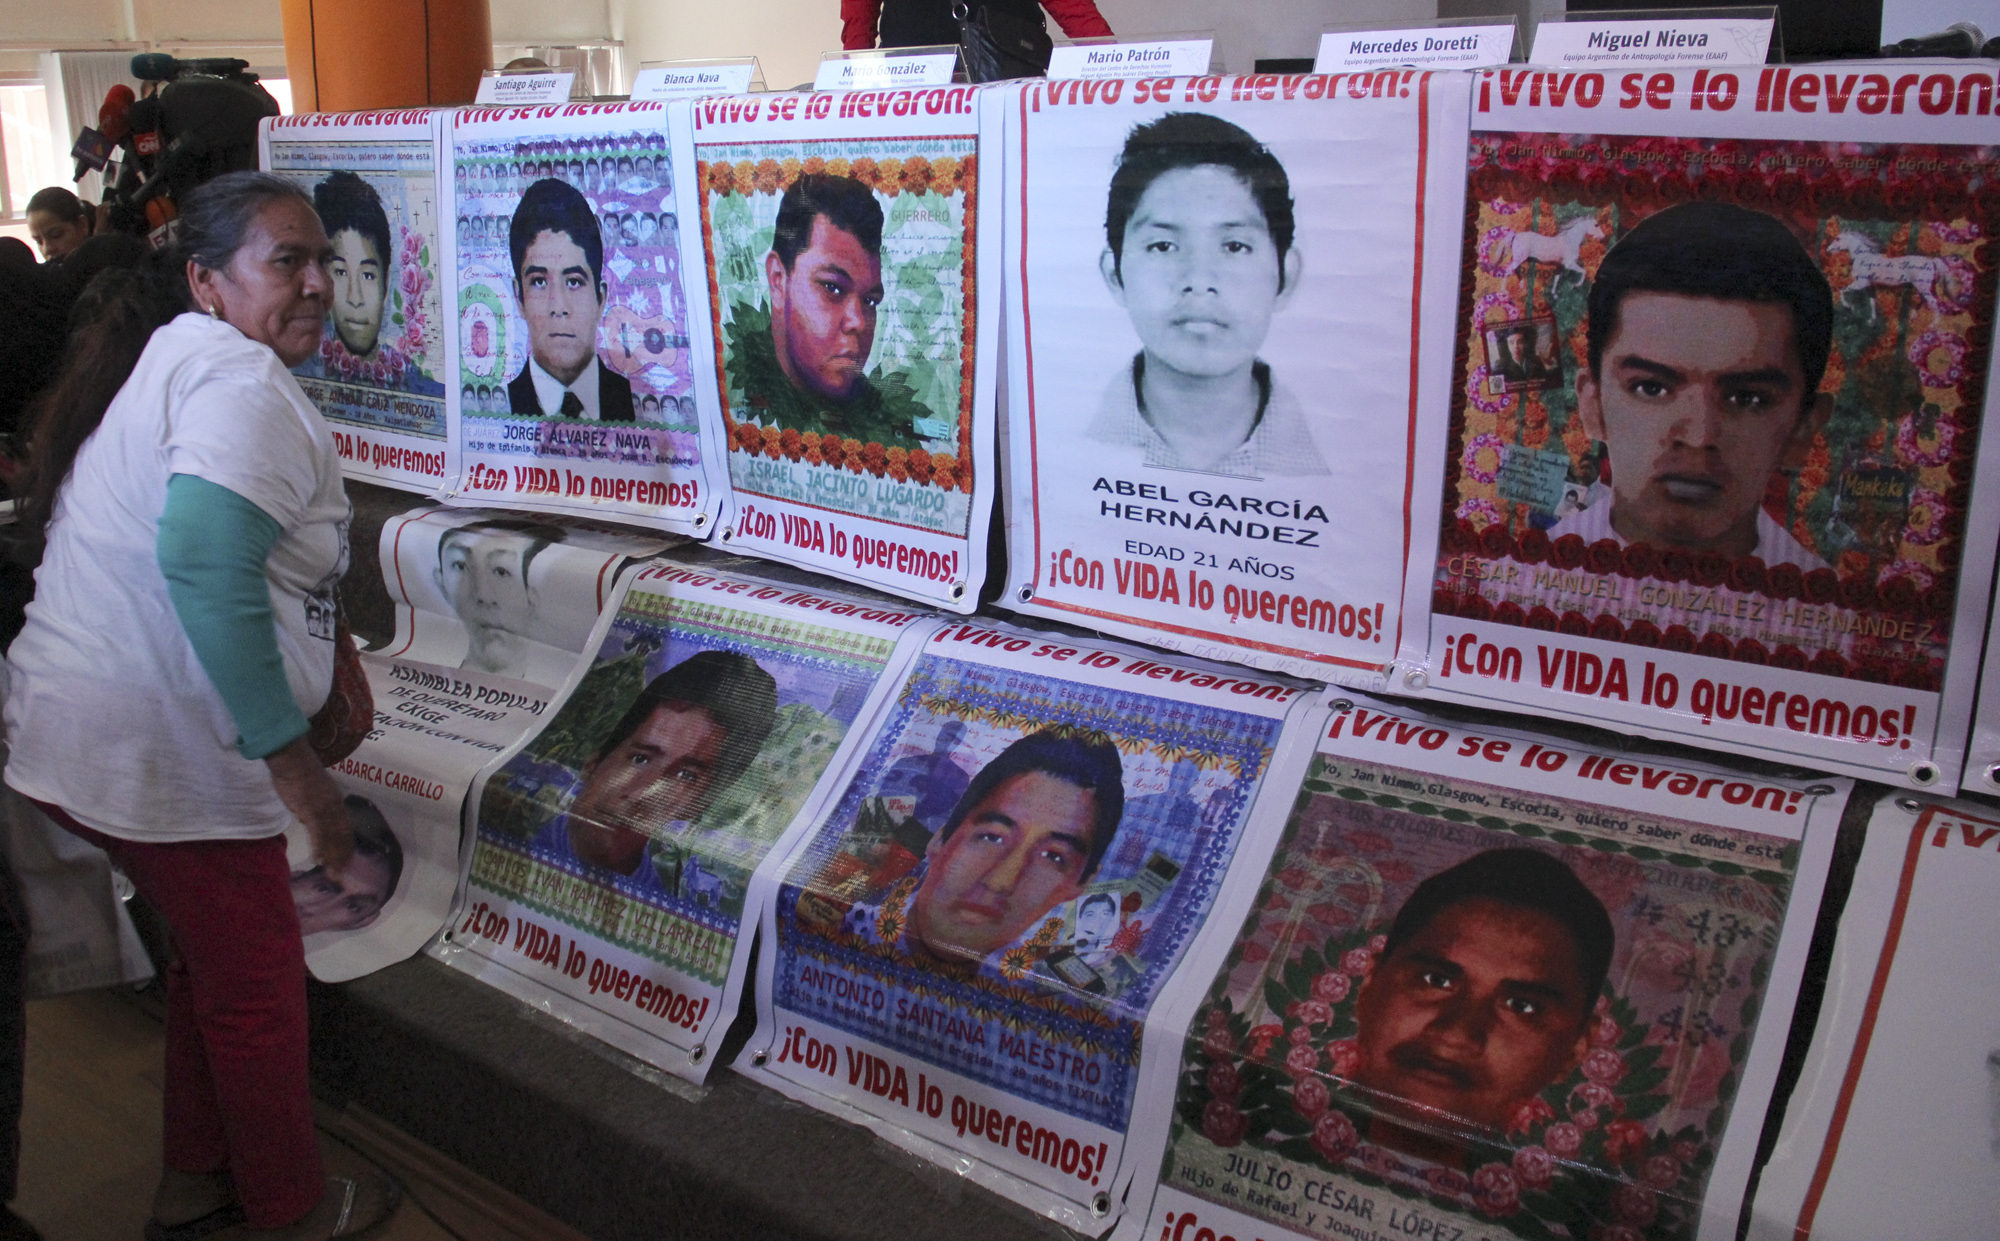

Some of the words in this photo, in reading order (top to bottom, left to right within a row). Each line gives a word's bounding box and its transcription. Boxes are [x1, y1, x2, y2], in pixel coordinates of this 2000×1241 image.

[1087, 49, 1123, 64] Mario
[1127, 46, 1170, 61] Patrón
[1349, 38, 1418, 54] Mercedes
[1423, 34, 1479, 51] Doretti
[1563, 53, 1586, 61] Equipo
[1587, 53, 1619, 61] Argentino
[1677, 52, 1704, 60] Forense
[1705, 52, 1728, 60] (EAAF)
[1588, 30, 1650, 51] Miguel
[1656, 29, 1709, 47] Nieva
[664, 74, 694, 84] Blanca
[697, 73, 719, 83] Nava
[876, 62, 926, 76] González
[1344, 58, 1363, 66] Equipo
[494, 79, 527, 91] Santiago
[527, 77, 557, 91] Aguirre
[1032, 78, 1125, 113] ¡Vivo
[1132, 78, 1173, 105] se
[1184, 75, 1221, 103] lo
[1230, 70, 1414, 102] llevaron!
[1477, 67, 1605, 113] ¡Vivo
[1618, 71, 1675, 110] se
[1690, 68, 1740, 112] lo
[695, 96, 761, 130] ¡Vivo
[766, 96, 796, 122] se
[804, 93, 832, 120] lo
[838, 86, 977, 119] llevaron!
[358, 152, 377, 162] quiero
[378, 152, 394, 160] saber
[396, 151, 413, 160] dónde
[416, 151, 430, 160] está
[884, 141, 911, 153] saber
[1602, 146, 1673, 166] Glasgow,
[1834, 153, 1885, 171] saber
[890, 209, 950, 223] GUERRERO
[366, 395, 389, 412] CRUZ
[393, 400, 436, 420] MENDOZA
[356, 435, 370, 462] lo
[372, 443, 446, 478] queremos!
[487, 441, 496, 451] de
[503, 424, 541, 442] JORGE
[615, 432, 651, 451] NAVA
[463, 462, 509, 493] ¡Con
[514, 466, 561, 497] VIDA
[565, 469, 585, 498] lo
[590, 475, 698, 509] queremos!
[748, 458, 796, 485] ISRAEL
[806, 468, 868, 498] JACINTO
[876, 482, 945, 512] LUGARDO
[1092, 477, 1179, 504] ABEL
[1189, 490, 1330, 524] GARCÍA
[737, 504, 776, 541] ¡Con
[780, 512, 824, 553] VIDA
[830, 522, 847, 558] lo
[853, 534, 958, 585] queremos!
[1100, 500, 1320, 548] HERNÁNDEZ
[1125, 540, 1185, 562] EDAD
[1193, 551, 1219, 569] 21
[1228, 554, 1295, 582] AÑOS
[638, 565, 710, 587] ¡Vivo
[712, 578, 749, 594] se
[747, 584, 783, 600] lo
[778, 591, 923, 628] llevaron!
[1049, 548, 1104, 591] ¡Con
[1114, 558, 1180, 606] VIDA
[1189, 570, 1214, 611] lo
[1224, 584, 1385, 644] queremos!
[1448, 556, 1519, 586] CÉSAR
[1532, 570, 1622, 601] MANUEL
[1638, 584, 1767, 622] GONZÁLEZ
[1780, 606, 1935, 646] HERNÁNDEZ
[644, 599, 658, 610] Jan
[660, 601, 686, 616] Nimmo,
[690, 607, 725, 623] Glasgow,
[729, 615, 766, 633] Escocia,
[770, 623, 801, 637] quiero
[389, 664, 473, 699] ASAMBLEA
[933, 623, 1031, 653] ¡Vivo
[1032, 640, 1080, 662] se
[1078, 650, 1123, 670] lo
[1121, 660, 1302, 703] llevaron!
[388, 686, 413, 698] DE
[412, 693, 508, 722] QUERÉTARO
[395, 701, 450, 725] EXIGE
[943, 664, 961, 678] Jan
[965, 668, 999, 686] Nimmo,
[1006, 676, 1053, 698] Glasgow,
[1059, 688, 1109, 707] Escocia,
[1116, 699, 1156, 718] quiero
[1161, 706, 1197, 723] saber
[1200, 713, 1238, 731] dónde
[1441, 633, 1523, 683] ¡Con
[1538, 645, 1629, 702] VIDA
[1641, 661, 1679, 710] lo
[1691, 677, 1918, 751] queremos!
[338, 759, 382, 785] ABARCA
[385, 770, 444, 801] CARRILLO
[1326, 709, 1450, 750] ¡Vivo
[1456, 736, 1513, 763] se
[1519, 744, 1569, 772] lo
[1576, 754, 1807, 815] llevaron!
[1322, 761, 1342, 779] Yo,
[1350, 767, 1377, 783] Jan
[1499, 795, 1565, 822] Escocia,
[1575, 809, 1629, 834] quiero
[1636, 818, 1684, 843] saber
[1689, 829, 1738, 854] dónde
[483, 849, 529, 879] CARLOS
[532, 867, 566, 895] IVÁN
[569, 883, 628, 919] RAMÍREZ
[634, 907, 719, 957] VILLARREAL
[460, 901, 510, 945] ¡Con
[515, 917, 561, 971] VIDA
[562, 939, 587, 979] lo
[588, 958, 710, 1034] queremos!
[800, 965, 885, 1011] ANTONIO
[895, 998, 986, 1048] SANTANA
[998, 1033, 1101, 1085] MAESTRO
[777, 1026, 838, 1077] ¡Con
[846, 1045, 909, 1107] VIDA
[916, 1073, 944, 1120] lo
[951, 1095, 1109, 1187] queremos!
[1181, 1166, 1215, 1188] Hijo
[1221, 1181, 1240, 1197] de
[1246, 1189, 1298, 1218] Rafael
[1305, 1211, 1317, 1227] y
[1223, 1153, 1293, 1192] JULIO
[1303, 1180, 1375, 1222] CÉSAR
[1388, 1207, 1465, 1241] LÓPEZ
